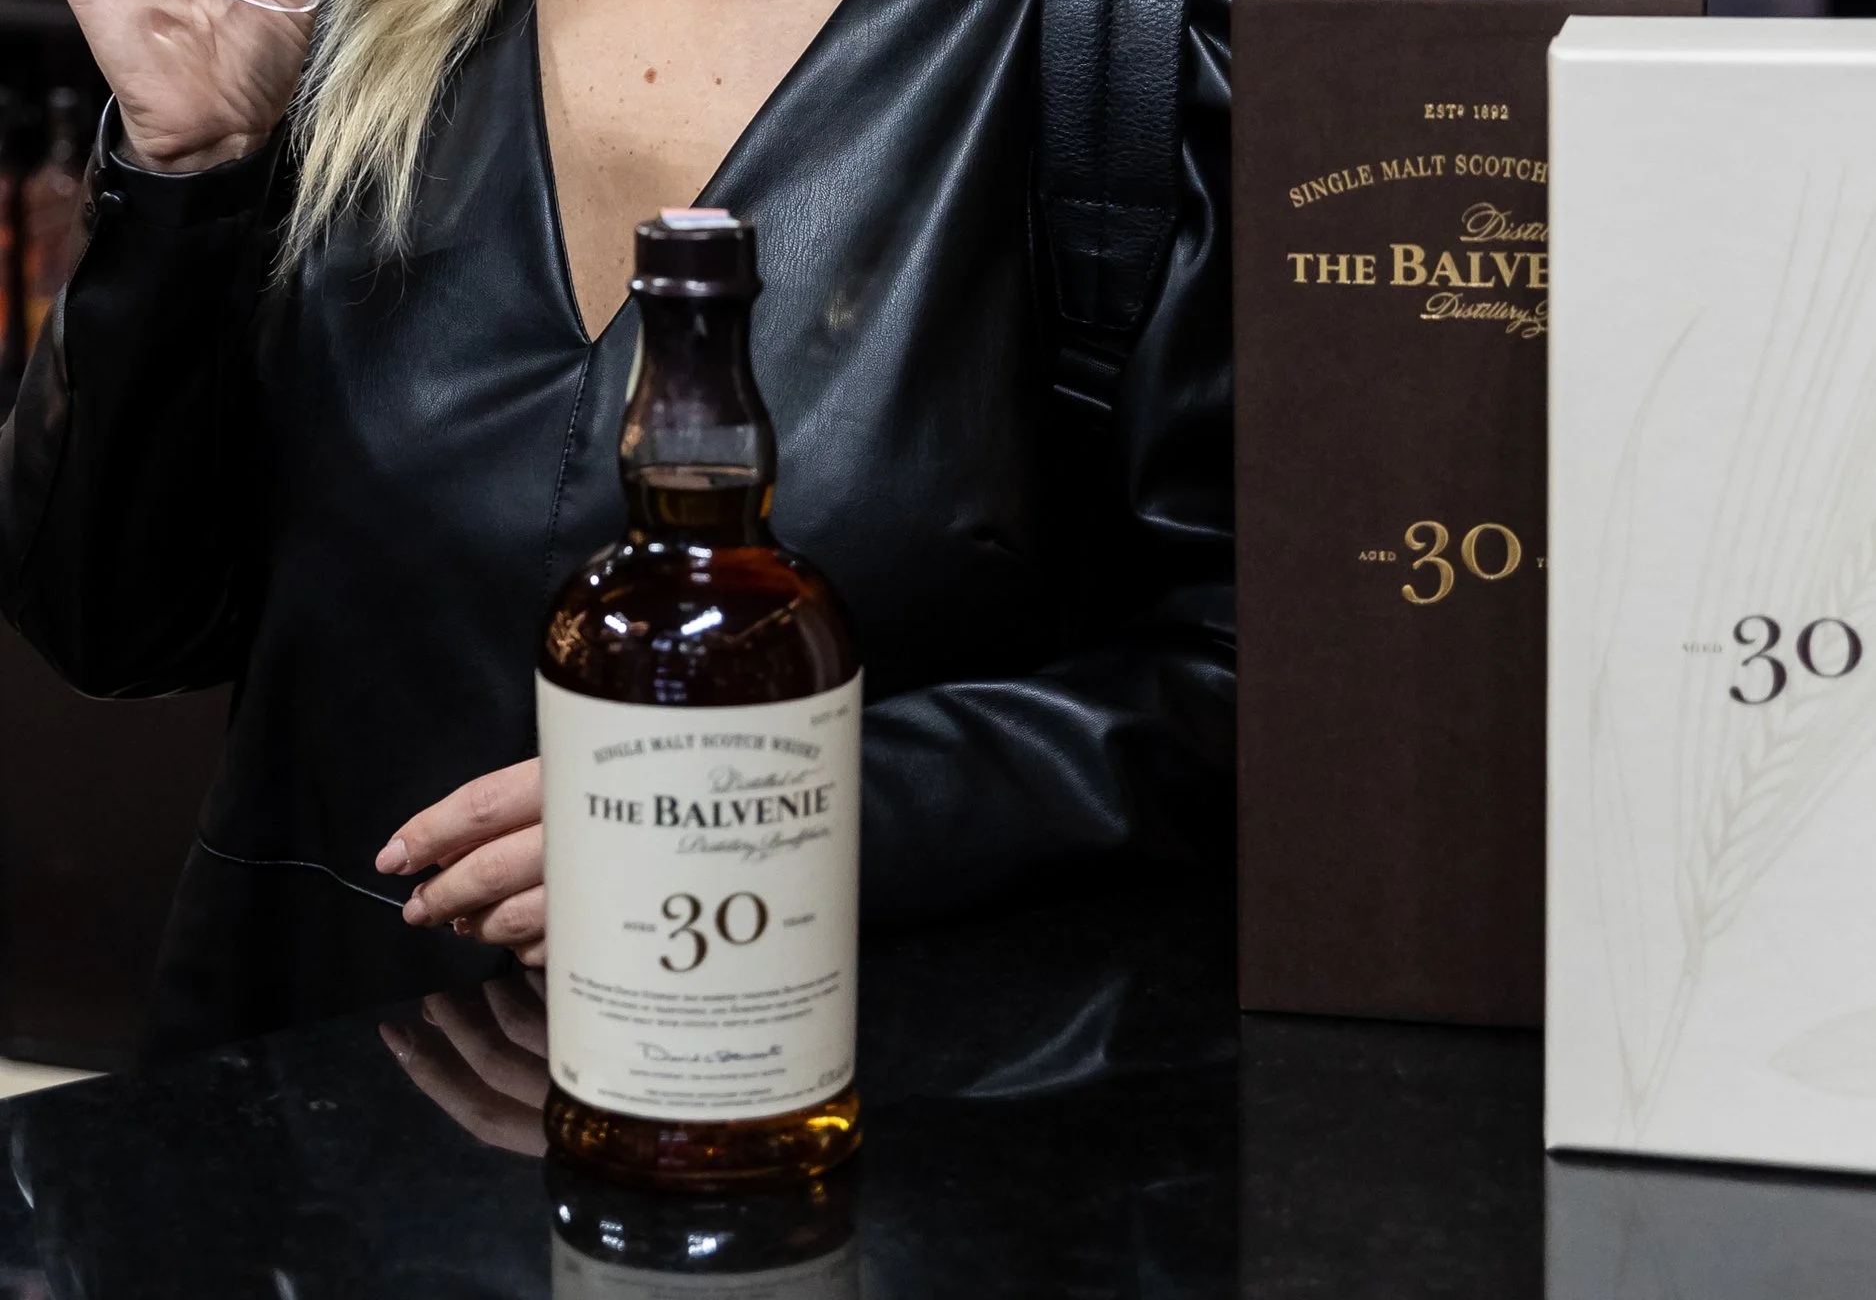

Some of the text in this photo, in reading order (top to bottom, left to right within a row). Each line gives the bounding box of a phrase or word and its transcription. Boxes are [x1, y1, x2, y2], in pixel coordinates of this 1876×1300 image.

[1289, 154, 1547, 208] SINGLE MALT SCOTCH
[1287, 252, 1376, 284] THE
[1402, 520, 1522, 604] 30
[1729, 614, 1863, 705] 30
[585, 782, 836, 830] THE BALVENIE
[660, 890, 769, 973] 30
